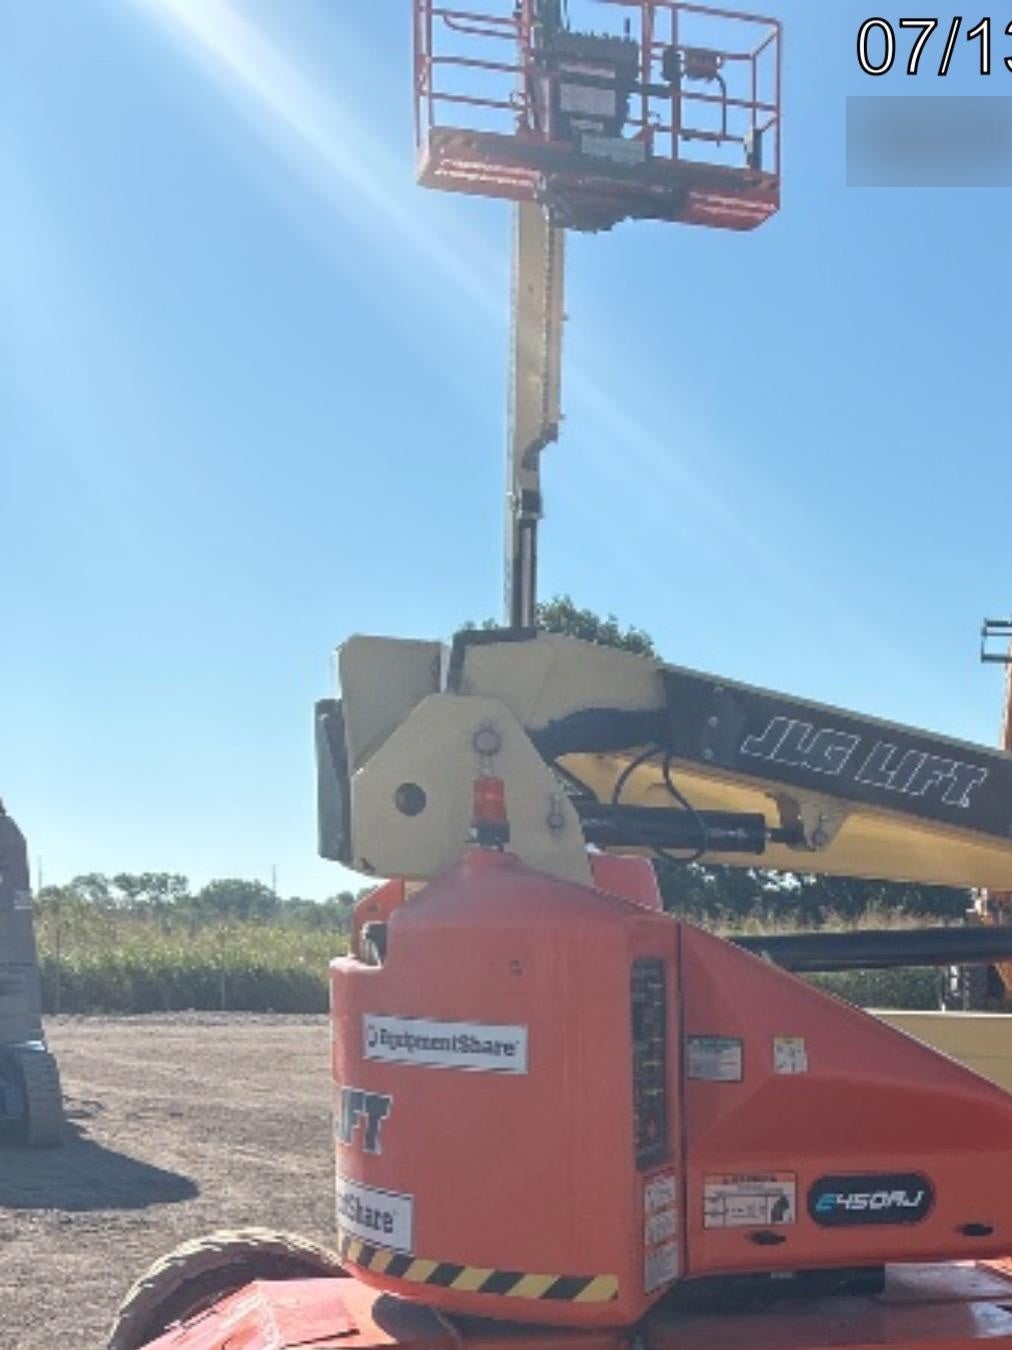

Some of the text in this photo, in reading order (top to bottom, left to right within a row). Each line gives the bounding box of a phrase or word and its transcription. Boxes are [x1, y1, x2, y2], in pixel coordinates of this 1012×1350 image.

[740, 716, 988, 808] JLG LIFT
[379, 1028, 516, 1057] EquipmentShare
[814, 1189, 926, 1213] E450AJ
